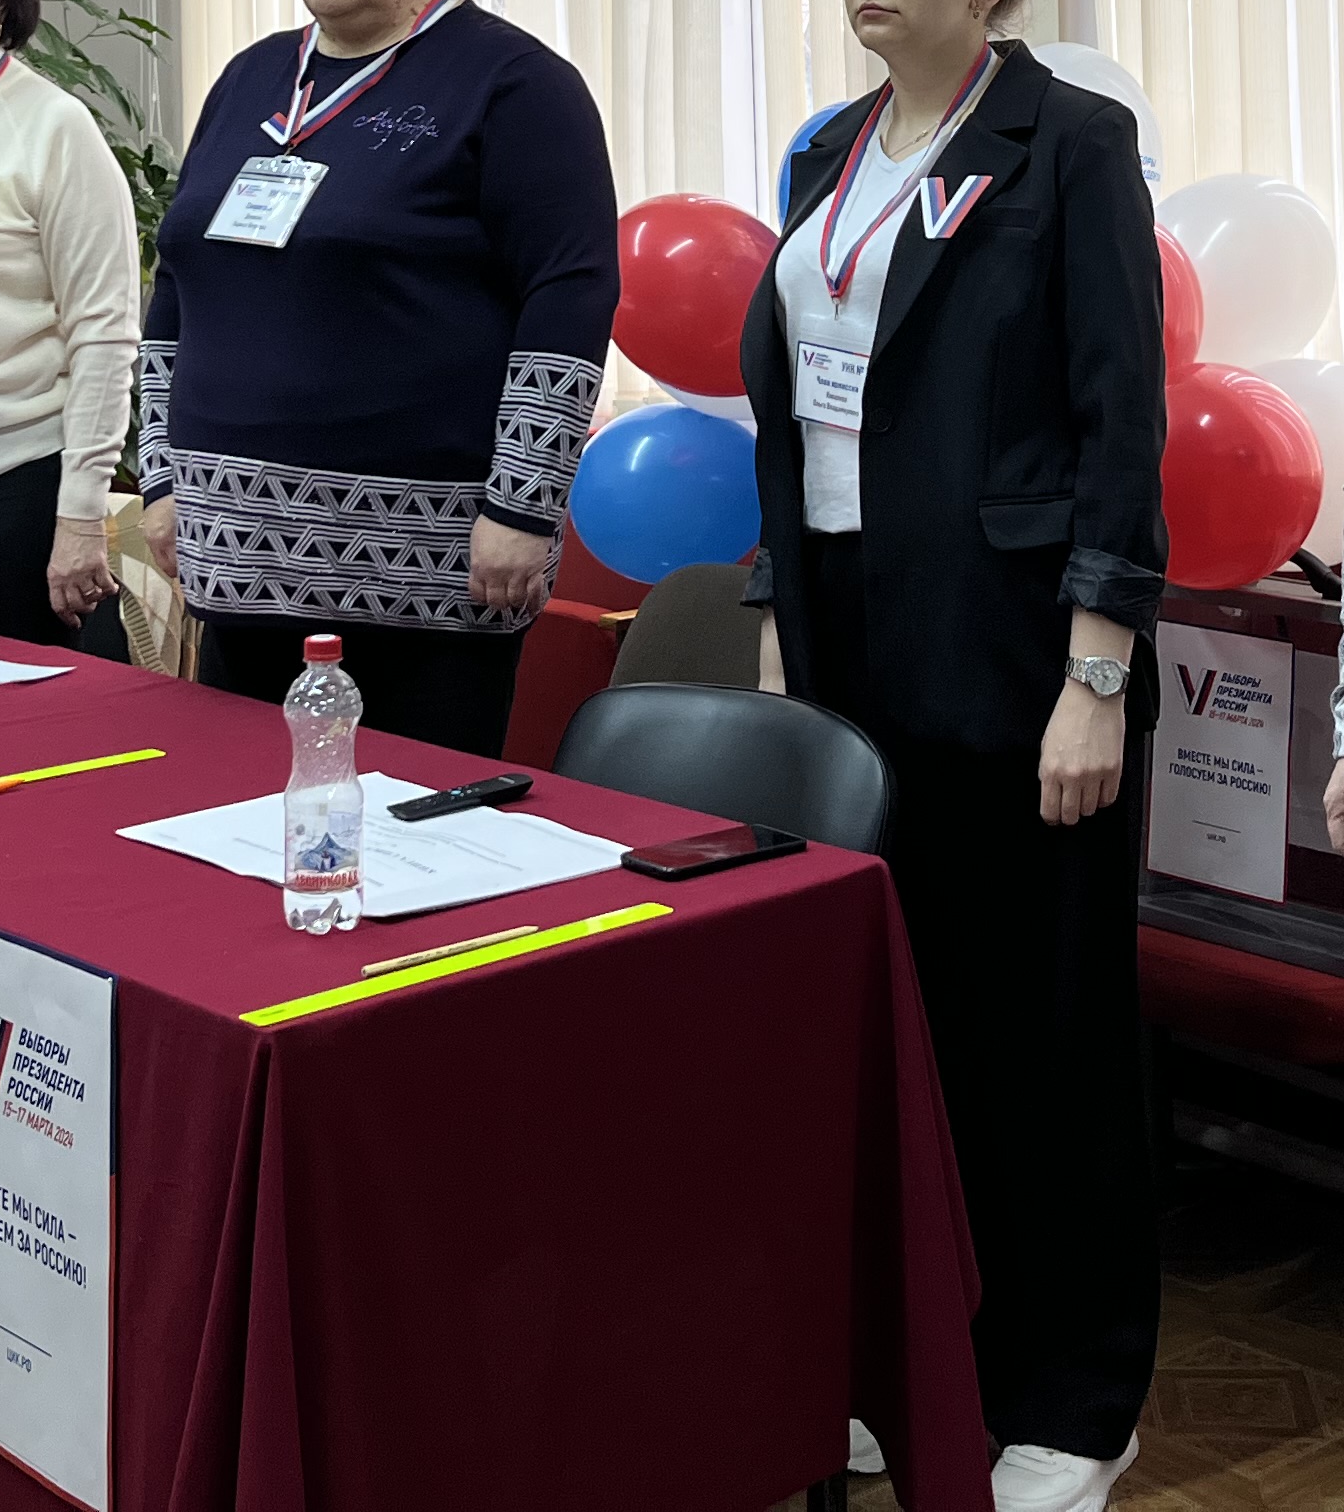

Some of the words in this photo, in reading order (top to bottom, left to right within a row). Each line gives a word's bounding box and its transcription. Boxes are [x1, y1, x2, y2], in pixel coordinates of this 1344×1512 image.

[1216, 685, 1272, 704] ПРЕЗИДЕНТА
[1220, 672, 1261, 688] ВЫБОРЫ
[1212, 697, 1248, 713] РОССИИ
[1169, 762, 1215, 782] ГОЛОСУЕМ
[1216, 772, 1228, 786] ЗА
[1229, 775, 1271, 795] РОССИЮ!
[1177, 748, 1211, 766] ВМЕСТЕ
[1213, 755, 1230, 770] МЫ
[1231, 759, 1255, 775] СИЛА
[18, 1027, 70, 1065] ВЫБОРЫ
[12, 1052, 84, 1101] ПРЕЗИДЕНТА
[6, 1077, 53, 1113] РОССИИ
[25, 1111, 54, 1138] МАРТА
[53, 1125, 74, 1149] 2024
[12, 1193, 32, 1223] МЫ
[34, 1206, 64, 1242] СИЛА
[16, 1228, 31, 1256] ЗА
[34, 1238, 86, 1288] РОССИЮ!
